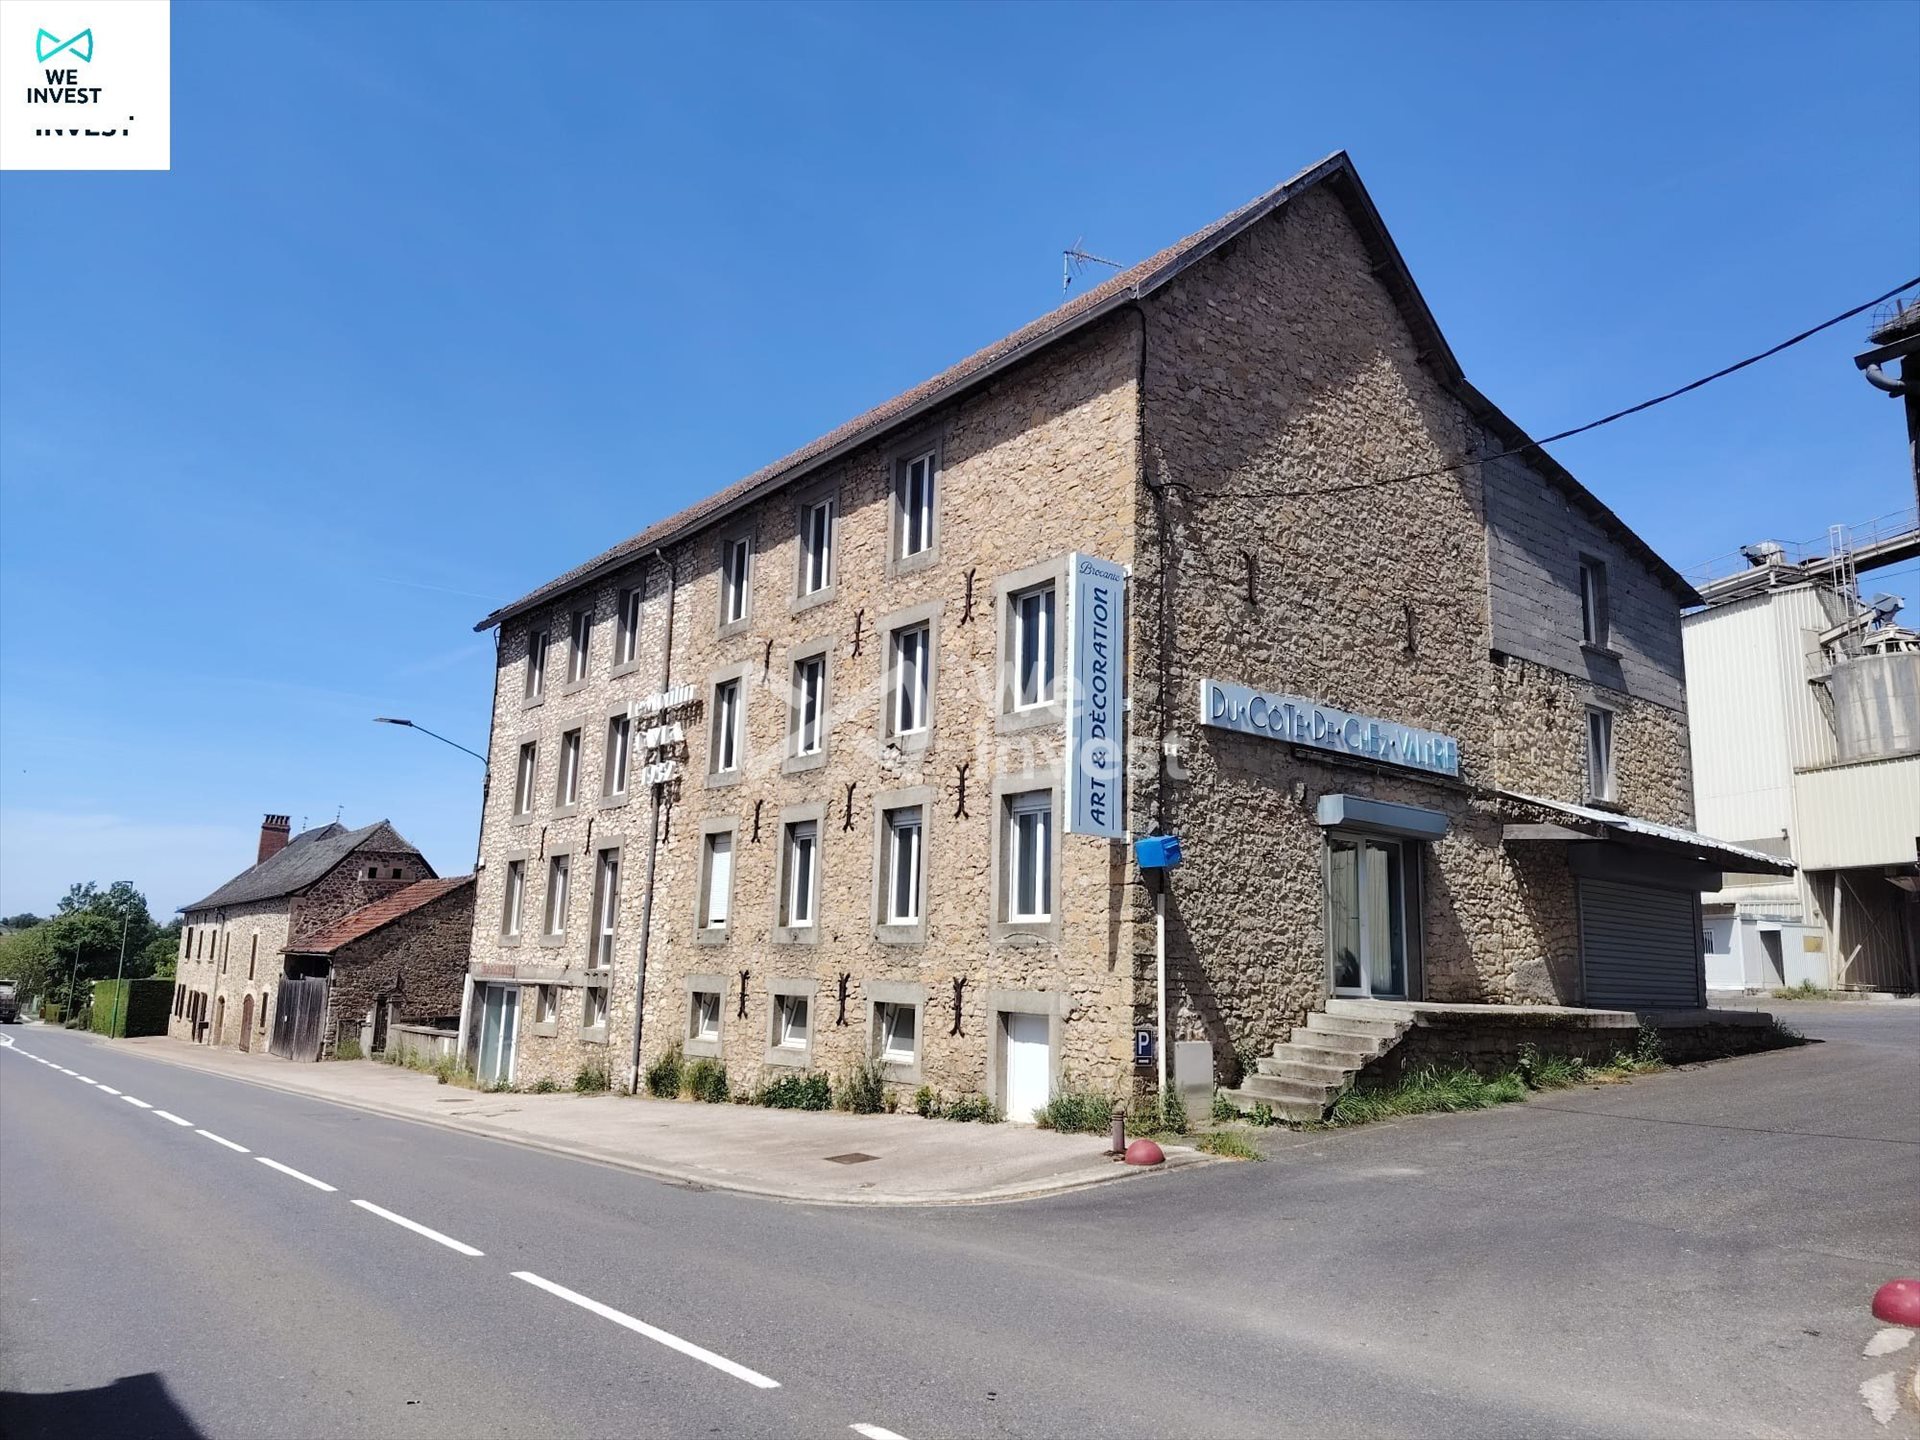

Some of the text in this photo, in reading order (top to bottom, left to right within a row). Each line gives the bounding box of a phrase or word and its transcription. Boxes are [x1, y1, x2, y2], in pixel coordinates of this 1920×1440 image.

[1079, 561, 1121, 582] Brocante
[1091, 751, 1107, 769] &
[1090, 777, 1106, 827] ART
[1138, 1031, 1150, 1055] P
